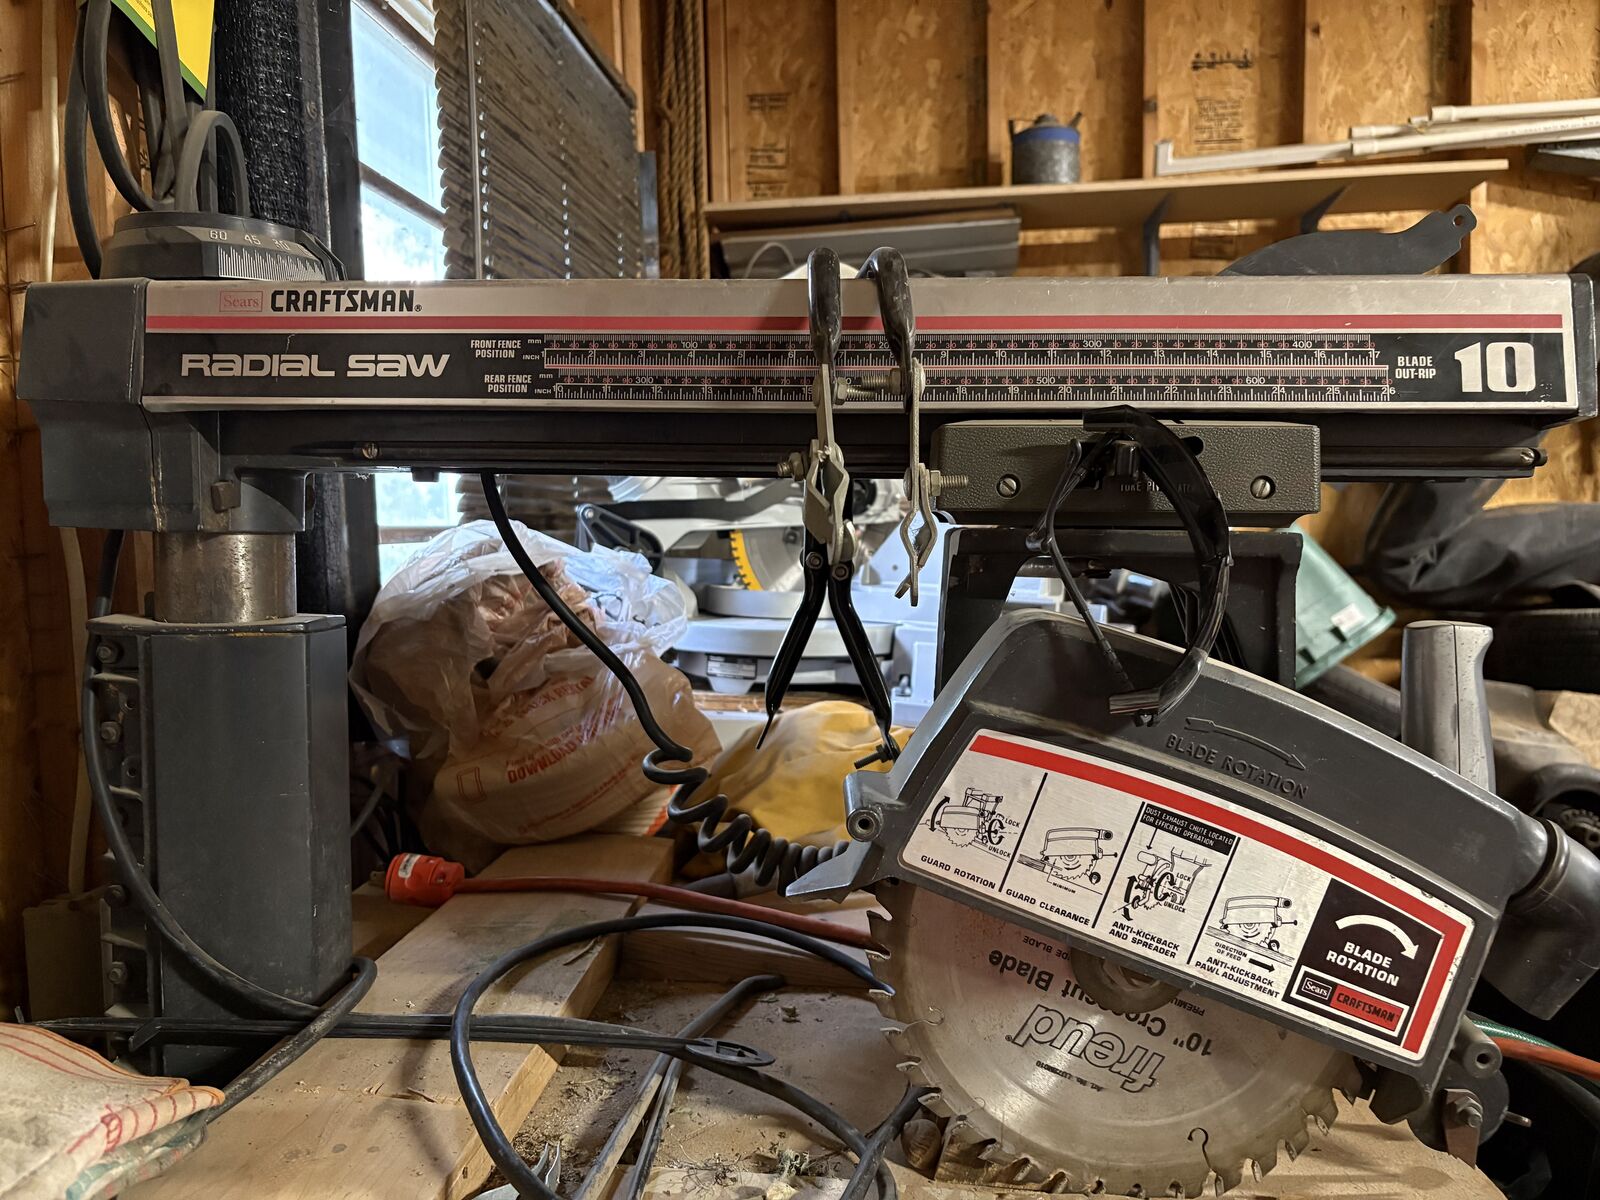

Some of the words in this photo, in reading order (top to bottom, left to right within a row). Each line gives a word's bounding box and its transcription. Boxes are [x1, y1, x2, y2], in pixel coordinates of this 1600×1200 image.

[210, 230, 227, 240] 60
[244, 234, 261, 245] 45
[223, 294, 259, 309] Sears
[470, 340, 496, 349] FRONT
[498, 340, 521, 349] FENCE
[475, 350, 515, 358] POSITION
[1398, 356, 1433, 366] BLADE
[1395, 368, 1436, 379] OUT-RIP
[1454, 342, 1536, 392] 10
[484, 374, 506, 383] REAR
[507, 374, 532, 383] FENCE
[488, 384, 528, 393] POSITION
[507, 741, 577, 784] DOWNLOAD
[1166, 733, 1219, 764] BLADE
[1221, 755, 1309, 799] ROTATION
[1005, 818, 1020, 828] LOCK
[1143, 815, 1154, 823] FOR
[1155, 818, 1182, 833] EFFICIENT
[1183, 830, 1214, 847] OPERATION
[1146, 807, 1160, 818] DUST
[1162, 812, 1188, 827] EXHAUST
[1189, 823, 1207, 836] CHUTE
[1208, 830, 1233, 845] LOCATED
[988, 845, 1011, 858] UNLOCK
[920, 855, 951, 871] GUARD
[954, 868, 996, 890] ROTATION
[1176, 872, 1191, 882] LOCK
[1006, 888, 1036, 905] GUARD
[1039, 901, 1090, 926] CLEARANCE
[1164, 900, 1186, 914] UNLOCK
[1023, 935, 1053, 952] BLADE
[1109, 929, 1128, 942] AND
[1131, 937, 1176, 958] SPREADER
[1112, 920, 1180, 951] ANTI-KICKBACK
[1214, 941, 1247, 958] DIRECTION
[1226, 952, 1241, 961] FEED
[1344, 941, 1392, 968] BLADE
[988, 949, 1054, 992] Blade
[1206, 956, 1274, 987] ANTI-KICKBACK
[1326, 950, 1399, 987] ROTATION
[1195, 960, 1220, 976] PAWL
[1222, 971, 1280, 998] ADJUSTMENT
[1305, 979, 1328, 997] Sears
[1171, 998, 1205, 1016] PREMIU
[1172, 1032, 1212, 1056] 10"
